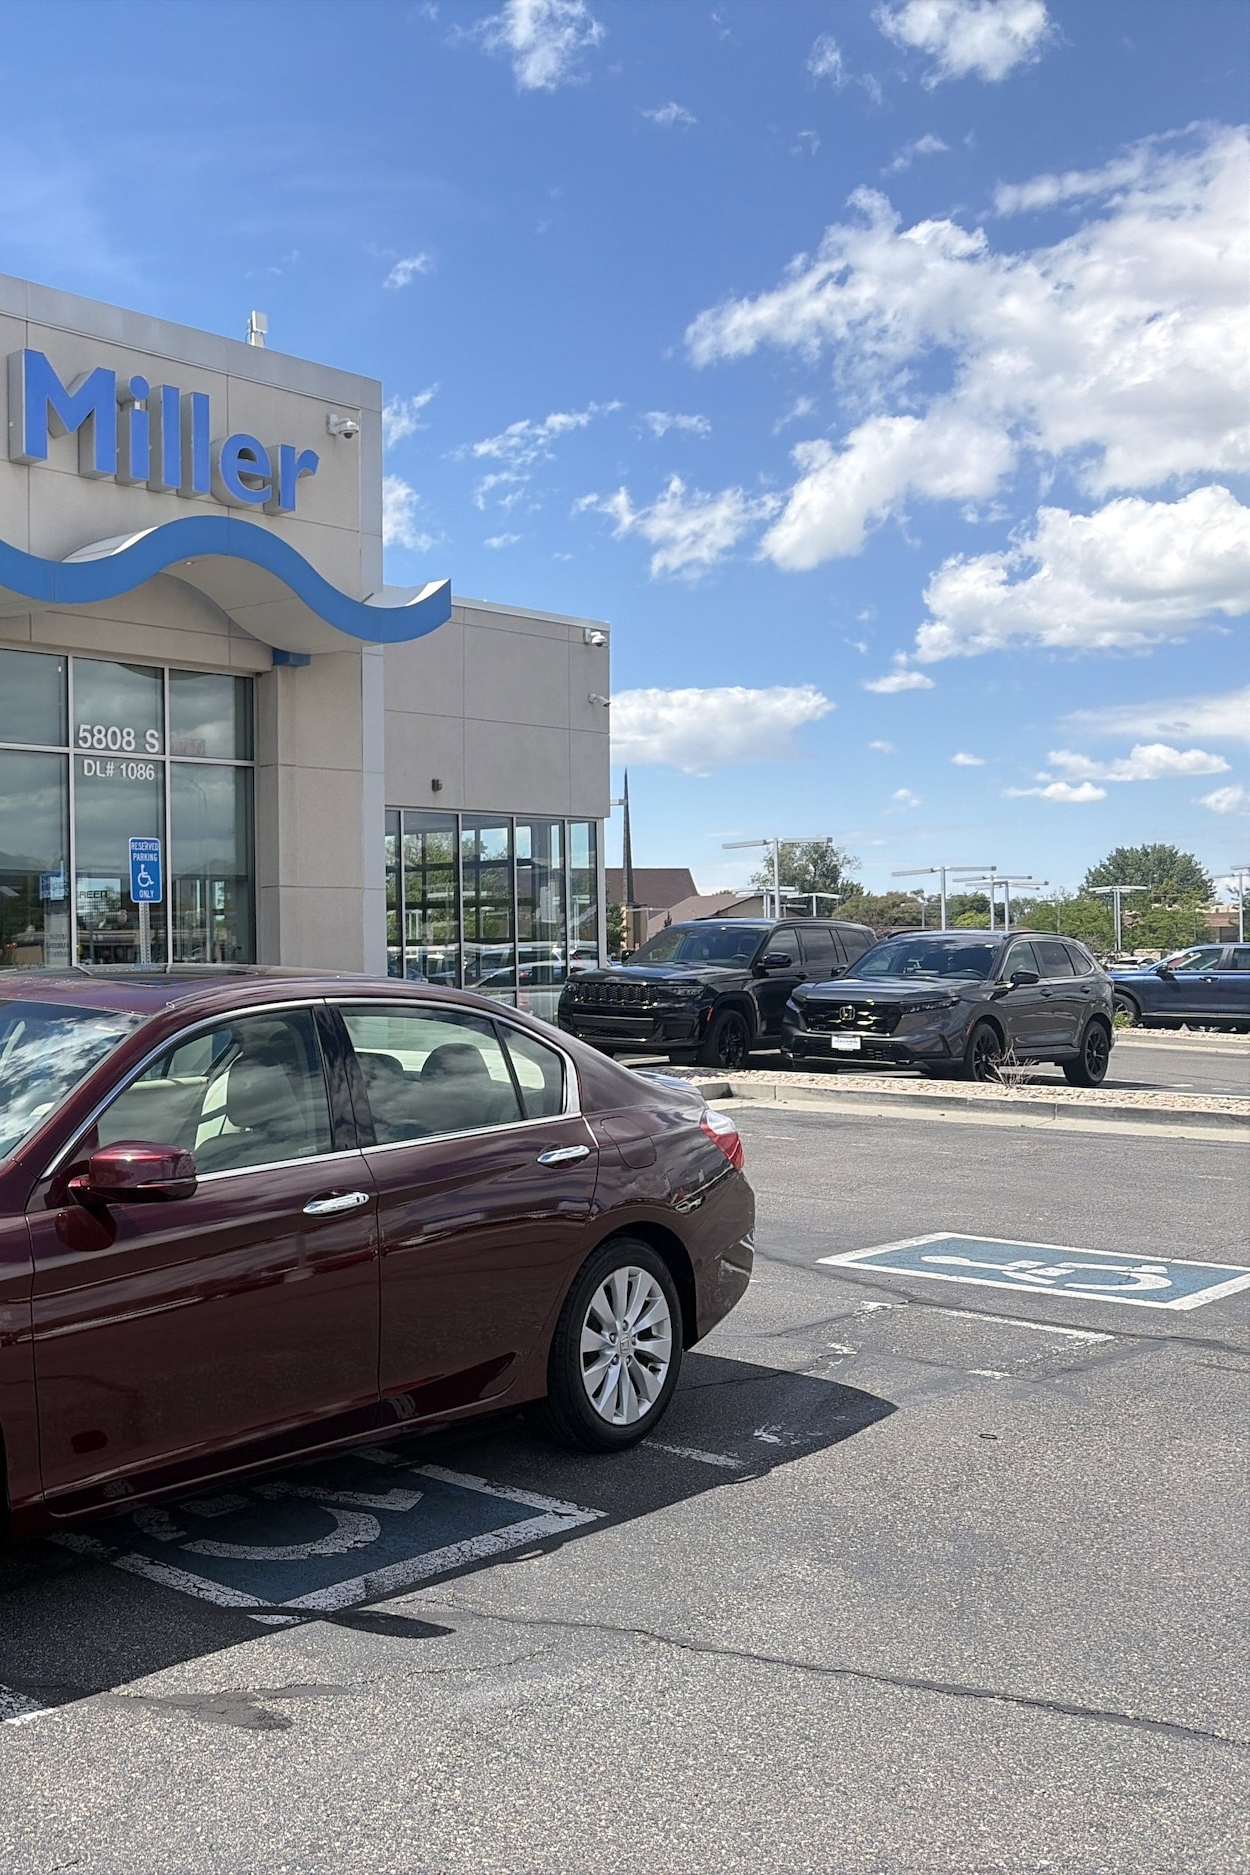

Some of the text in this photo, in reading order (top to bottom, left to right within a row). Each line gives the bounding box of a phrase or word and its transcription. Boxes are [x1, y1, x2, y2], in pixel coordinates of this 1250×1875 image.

[10, 348, 320, 513] Miller
[78, 724, 136, 752] 5808
[145, 729, 160, 754] S
[83, 759, 155, 781] DL# 1086
[130, 841, 159, 851] RESERVED
[132, 853, 158, 862] PARKING
[138, 889, 154, 899] ONLY
